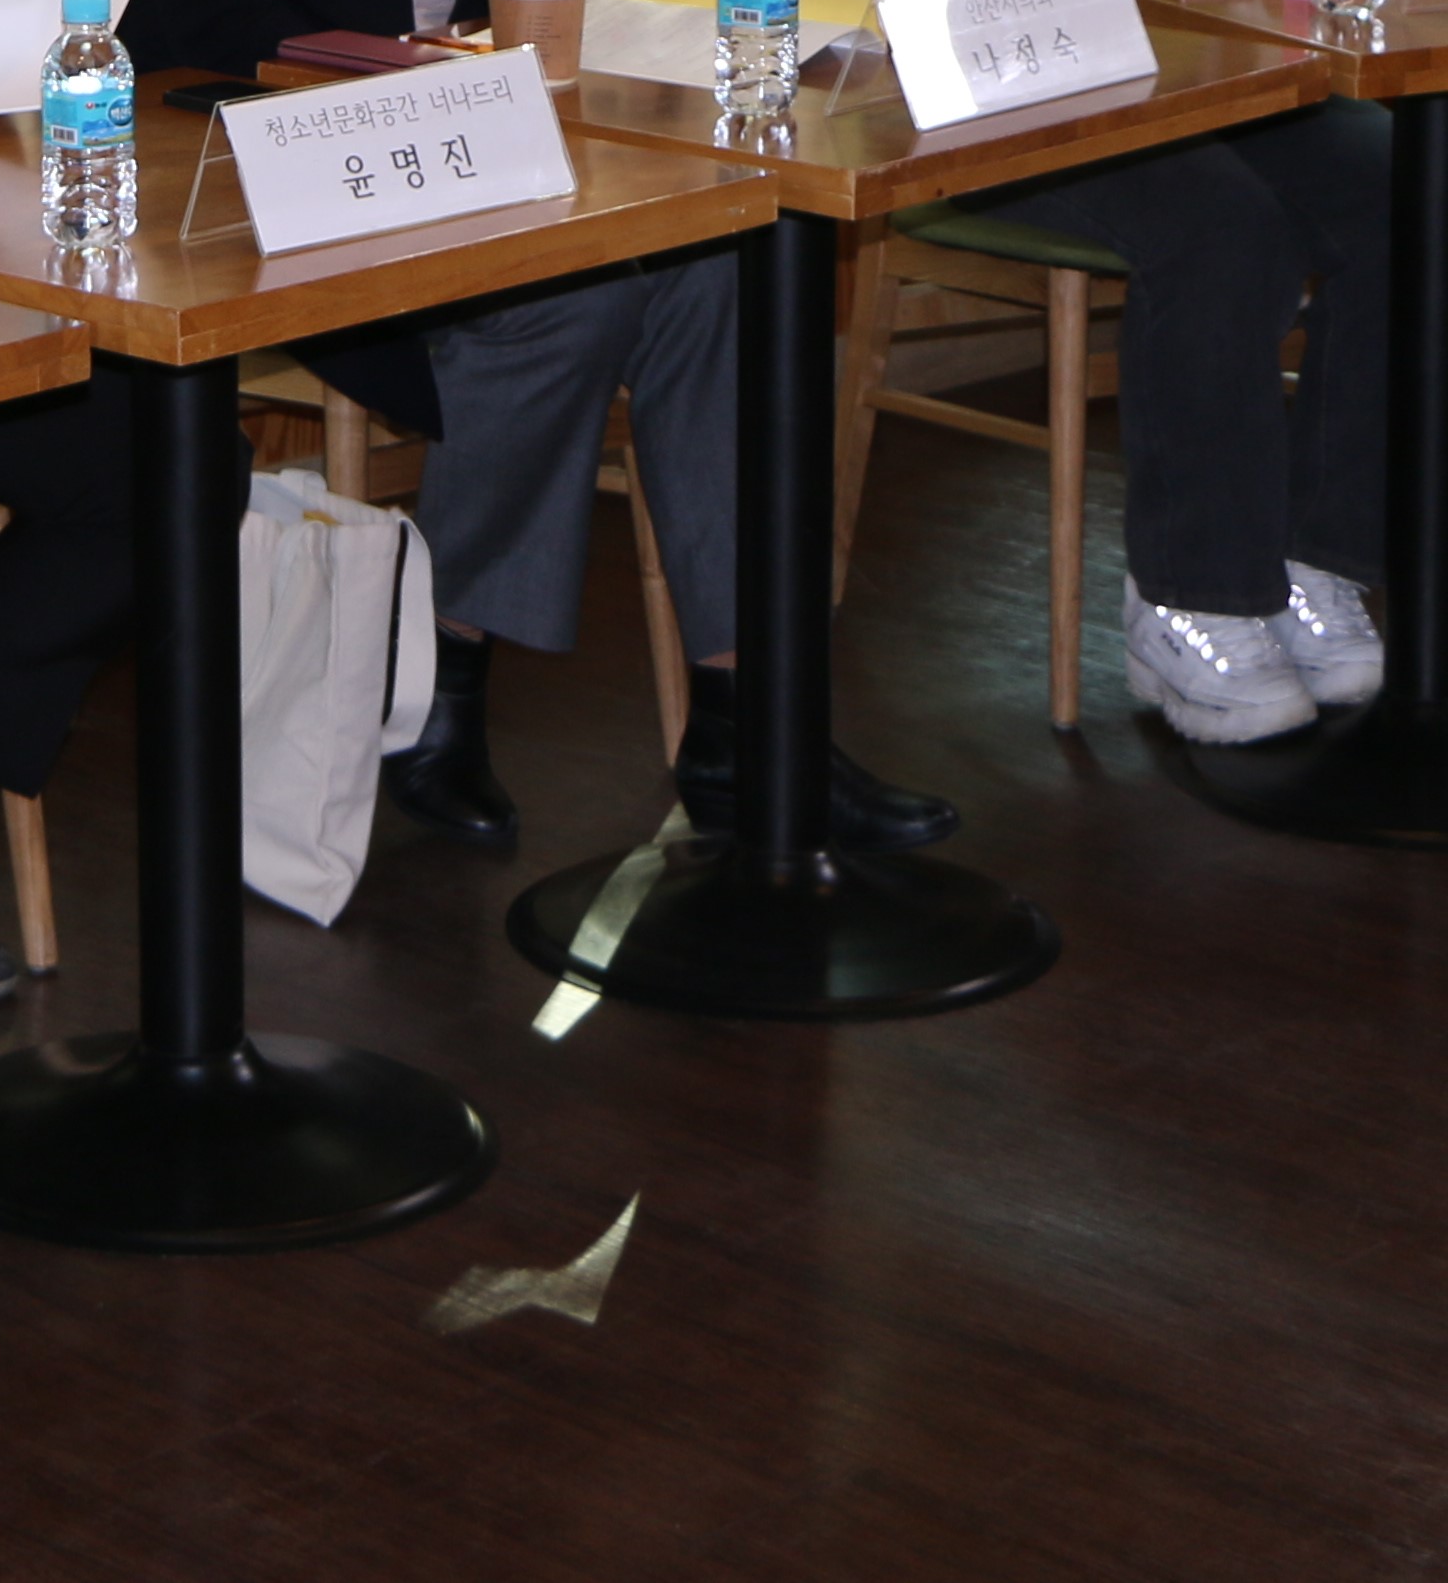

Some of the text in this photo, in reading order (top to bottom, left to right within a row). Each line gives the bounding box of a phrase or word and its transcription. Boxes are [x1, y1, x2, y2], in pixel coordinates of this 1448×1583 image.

[971, 26, 1079, 80] 나 정 숙
[264, 75, 515, 148] 청소년문화공간 너나드리
[342, 134, 478, 199] 윤 명 진
